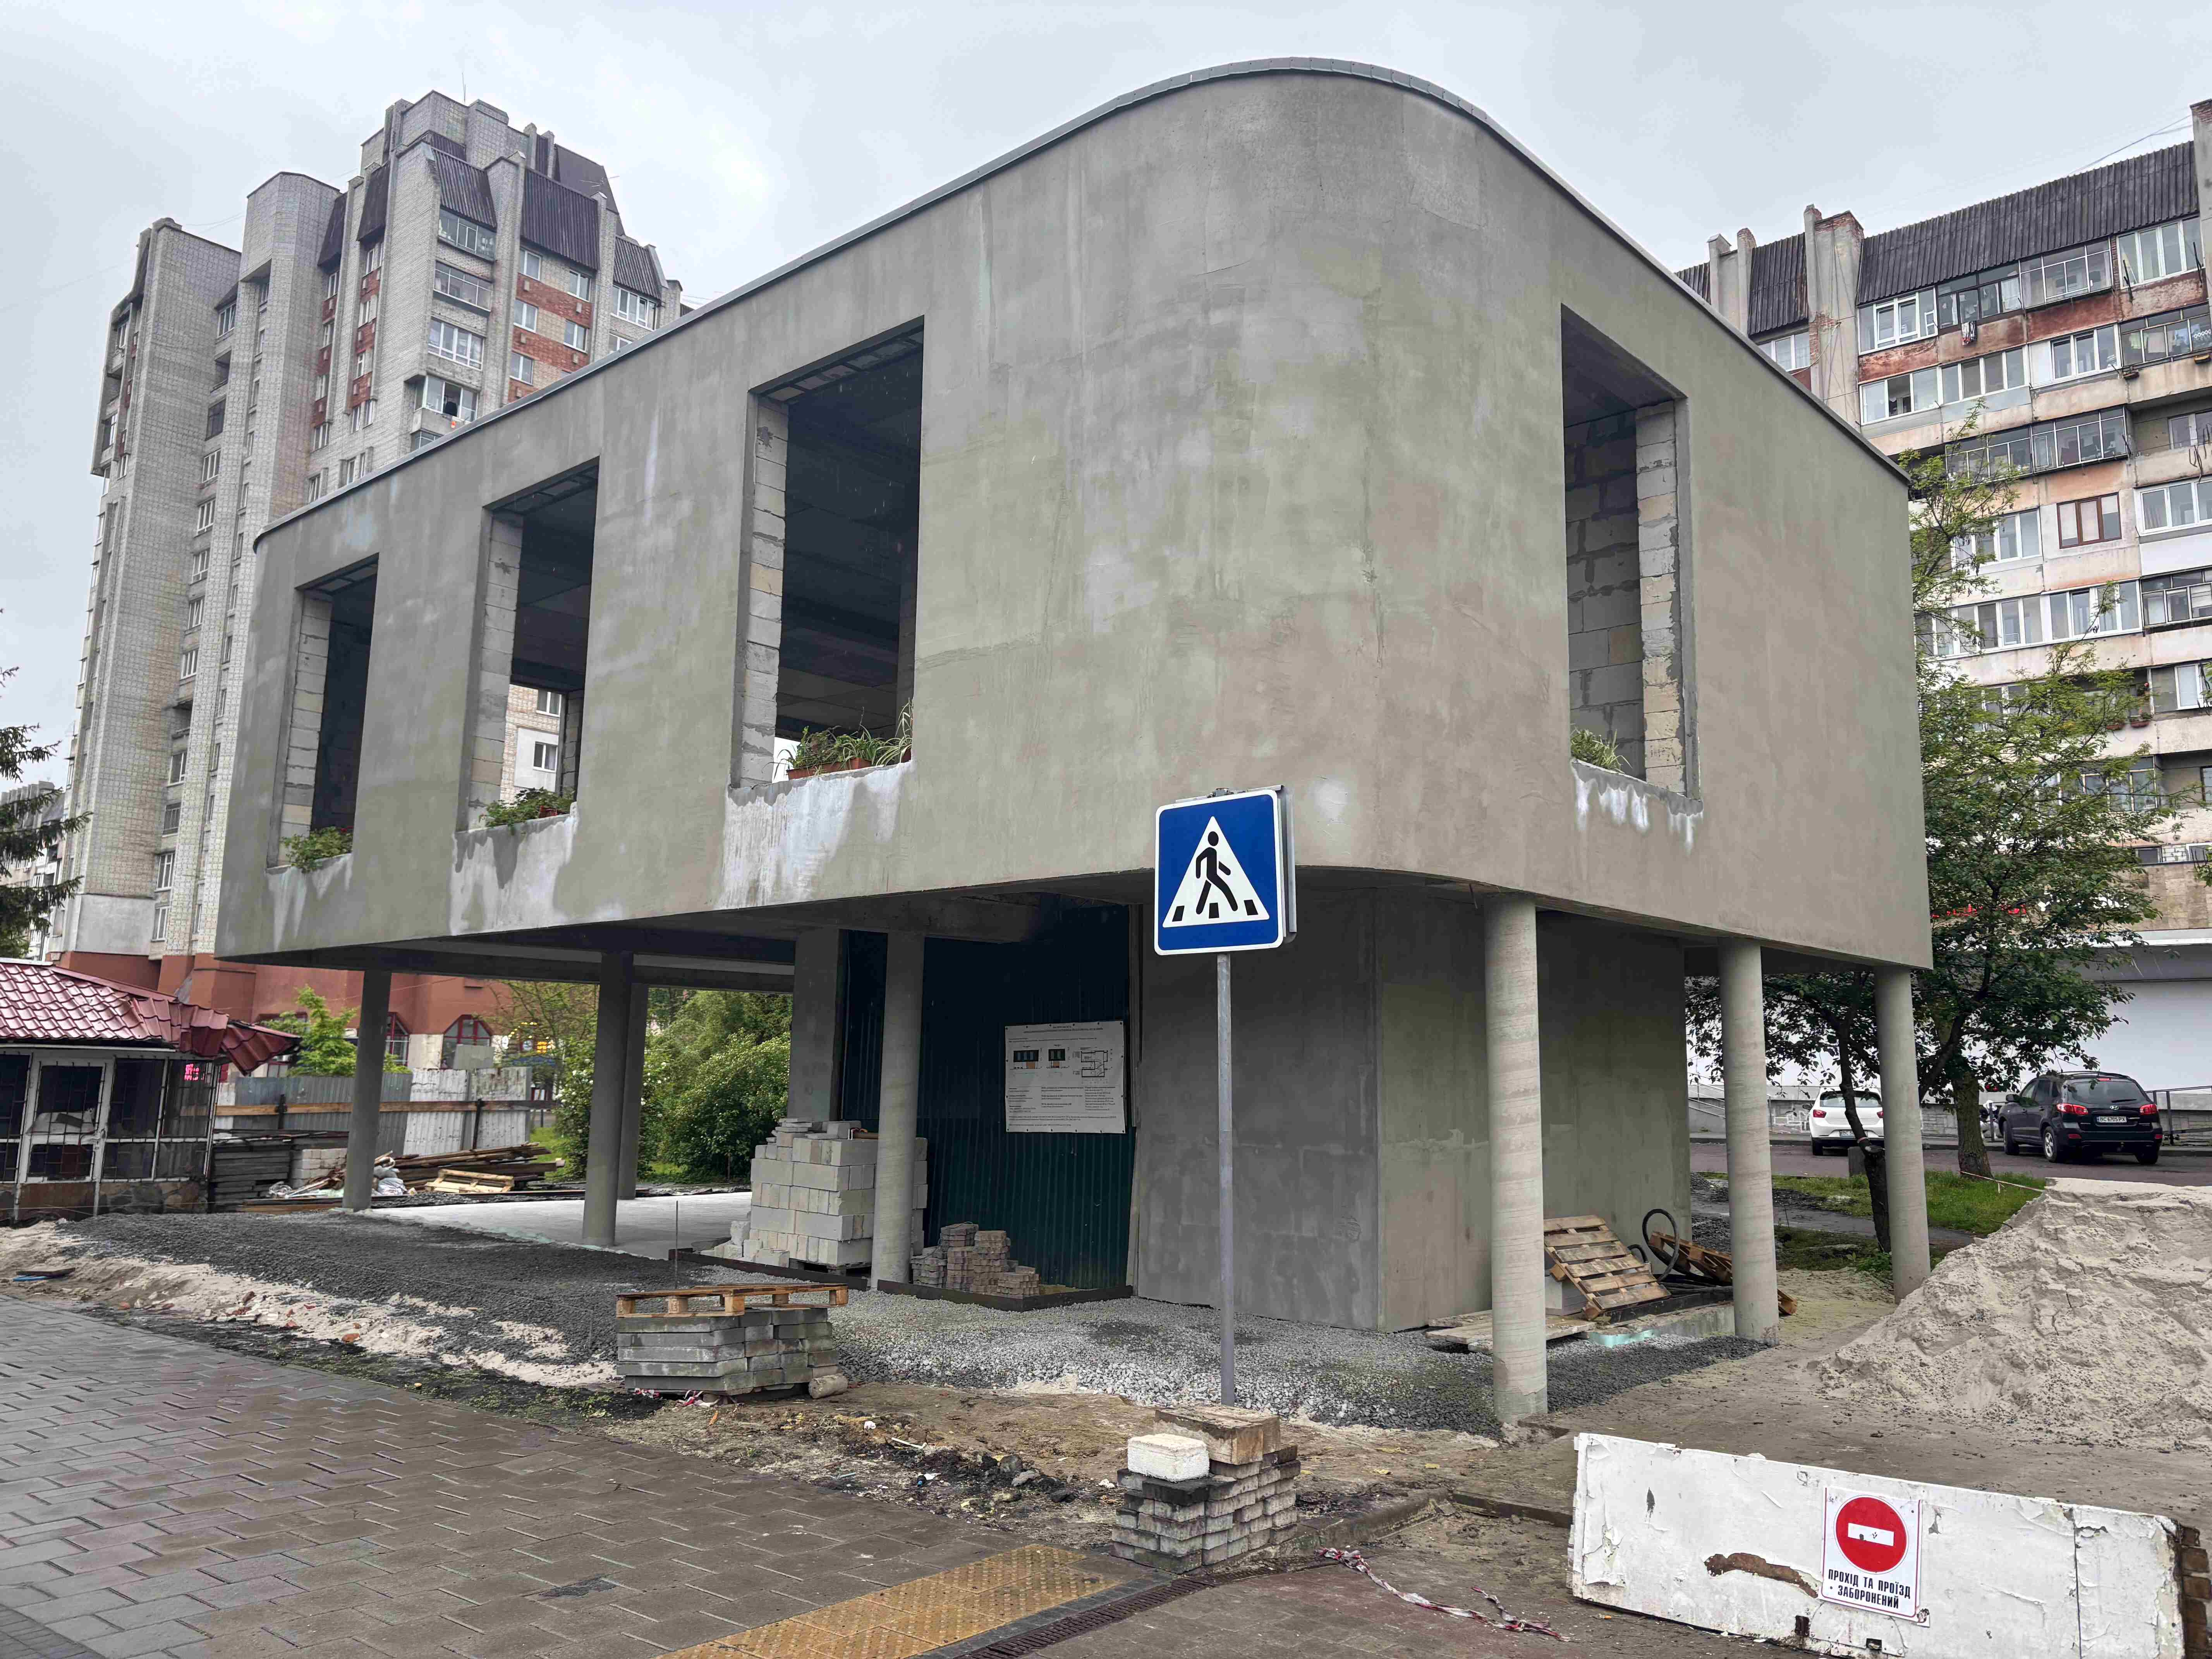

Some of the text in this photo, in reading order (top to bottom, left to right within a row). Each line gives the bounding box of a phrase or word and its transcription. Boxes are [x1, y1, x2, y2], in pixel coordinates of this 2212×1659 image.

[1828, 1569, 1910, 1599] ПРОХІД ТА ПРОЇЗД
[1838, 1585, 1899, 1609] ЗАБОРОНЕНИЙ
